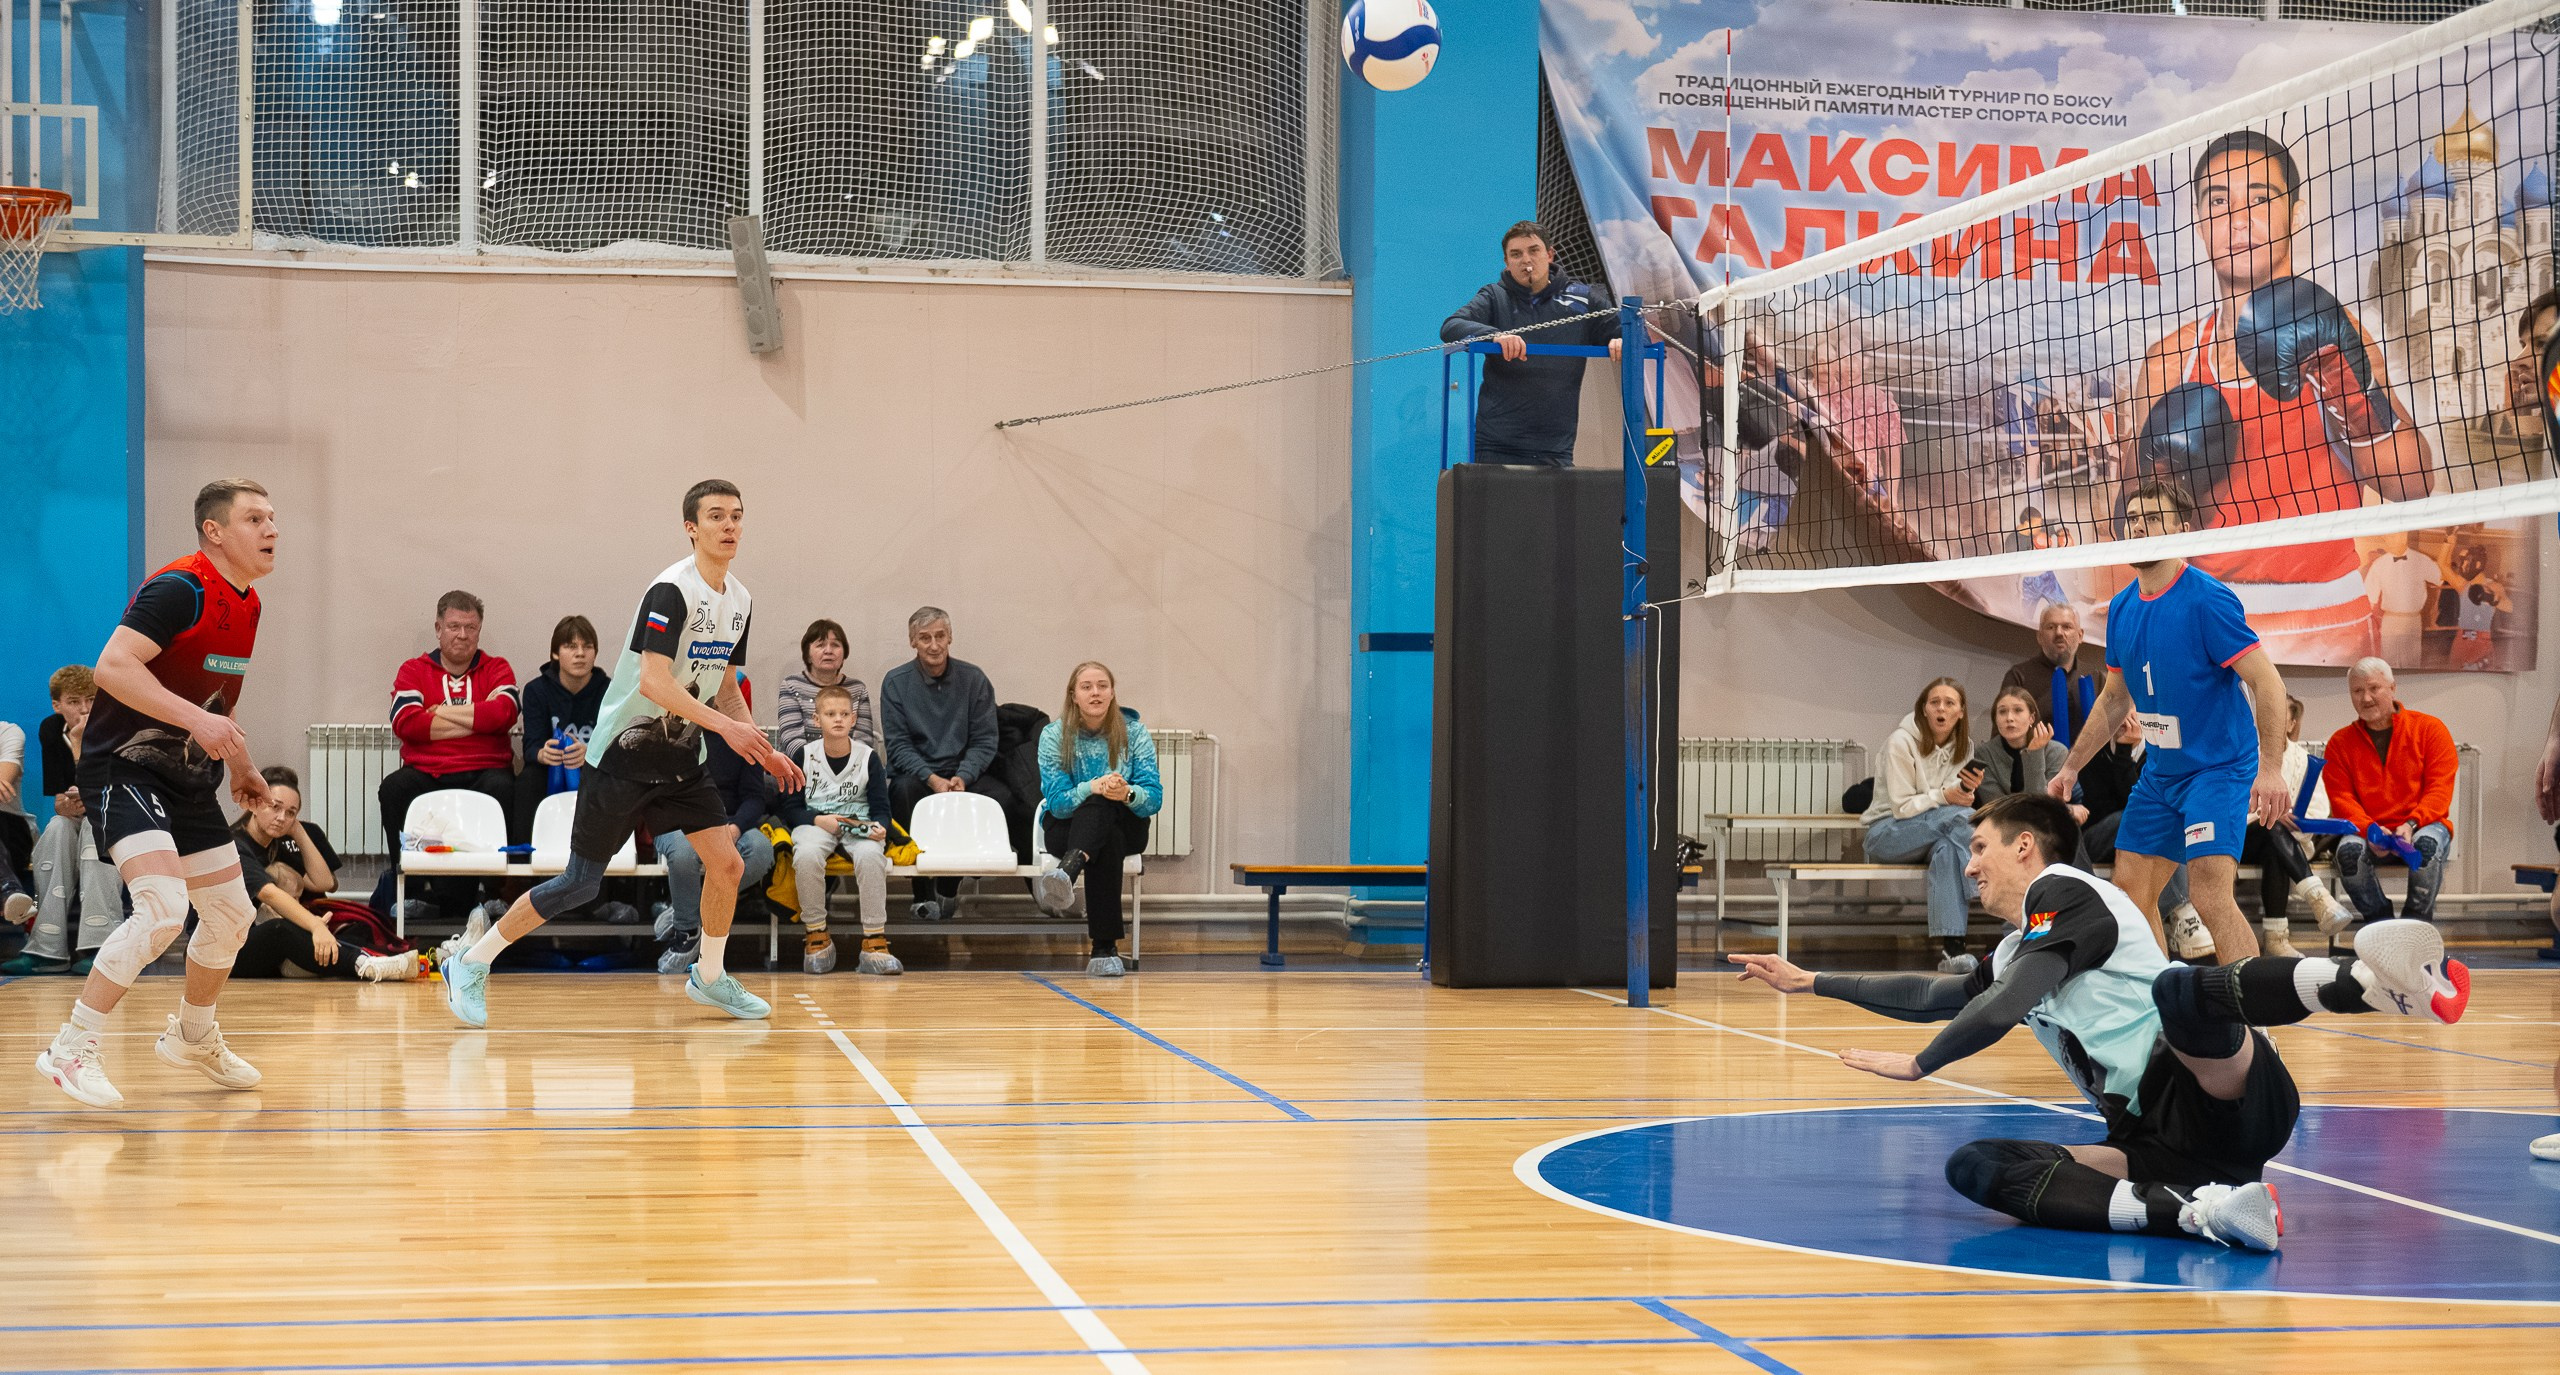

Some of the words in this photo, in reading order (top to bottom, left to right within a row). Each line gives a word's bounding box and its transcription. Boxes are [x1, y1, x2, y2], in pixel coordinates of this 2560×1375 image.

[1675, 74, 1822, 95] ТРАДИЦОННЫЙ
[1826, 82, 1945, 101] ЕЖЕГОДНЫЙ
[1949, 89, 2021, 105] ТУРНИР
[2024, 93, 2050, 106] ПО
[2053, 94, 2113, 109] БОКСУ
[1658, 92, 1810, 112] ПОСВЯЩЕННЫЙ
[1814, 99, 1894, 116] ПАМЯТИ
[1898, 104, 1973, 120] МАСТЕР
[1976, 108, 2049, 124] СПОРТА
[2052, 112, 2128, 127] РОССИИ
[690, 607, 716, 634] 24
[2142, 660, 2155, 696] 1
[150, 792, 166, 818] 5
